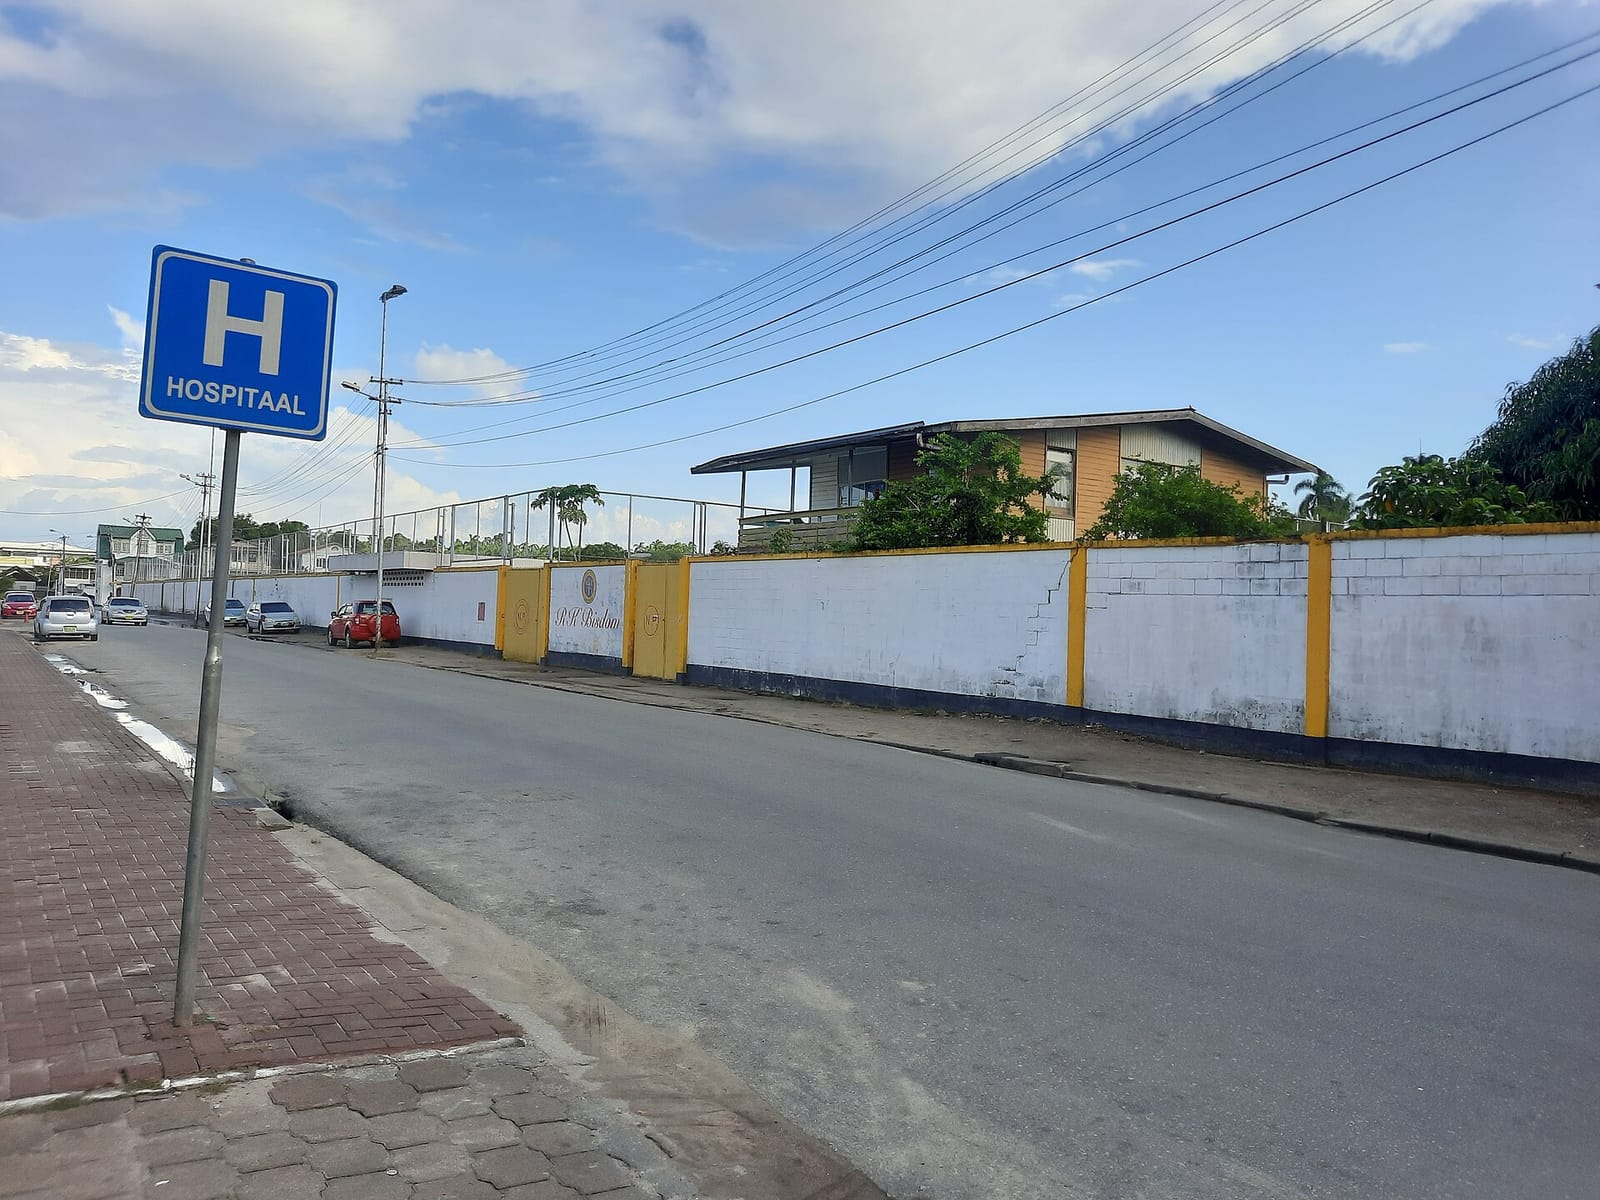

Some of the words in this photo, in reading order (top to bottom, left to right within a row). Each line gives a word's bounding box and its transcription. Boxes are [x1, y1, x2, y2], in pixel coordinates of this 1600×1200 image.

[203, 279, 285, 376] H
[167, 376, 306, 416] HOSPITAAL
[581, 607, 620, 629] Bisdom
